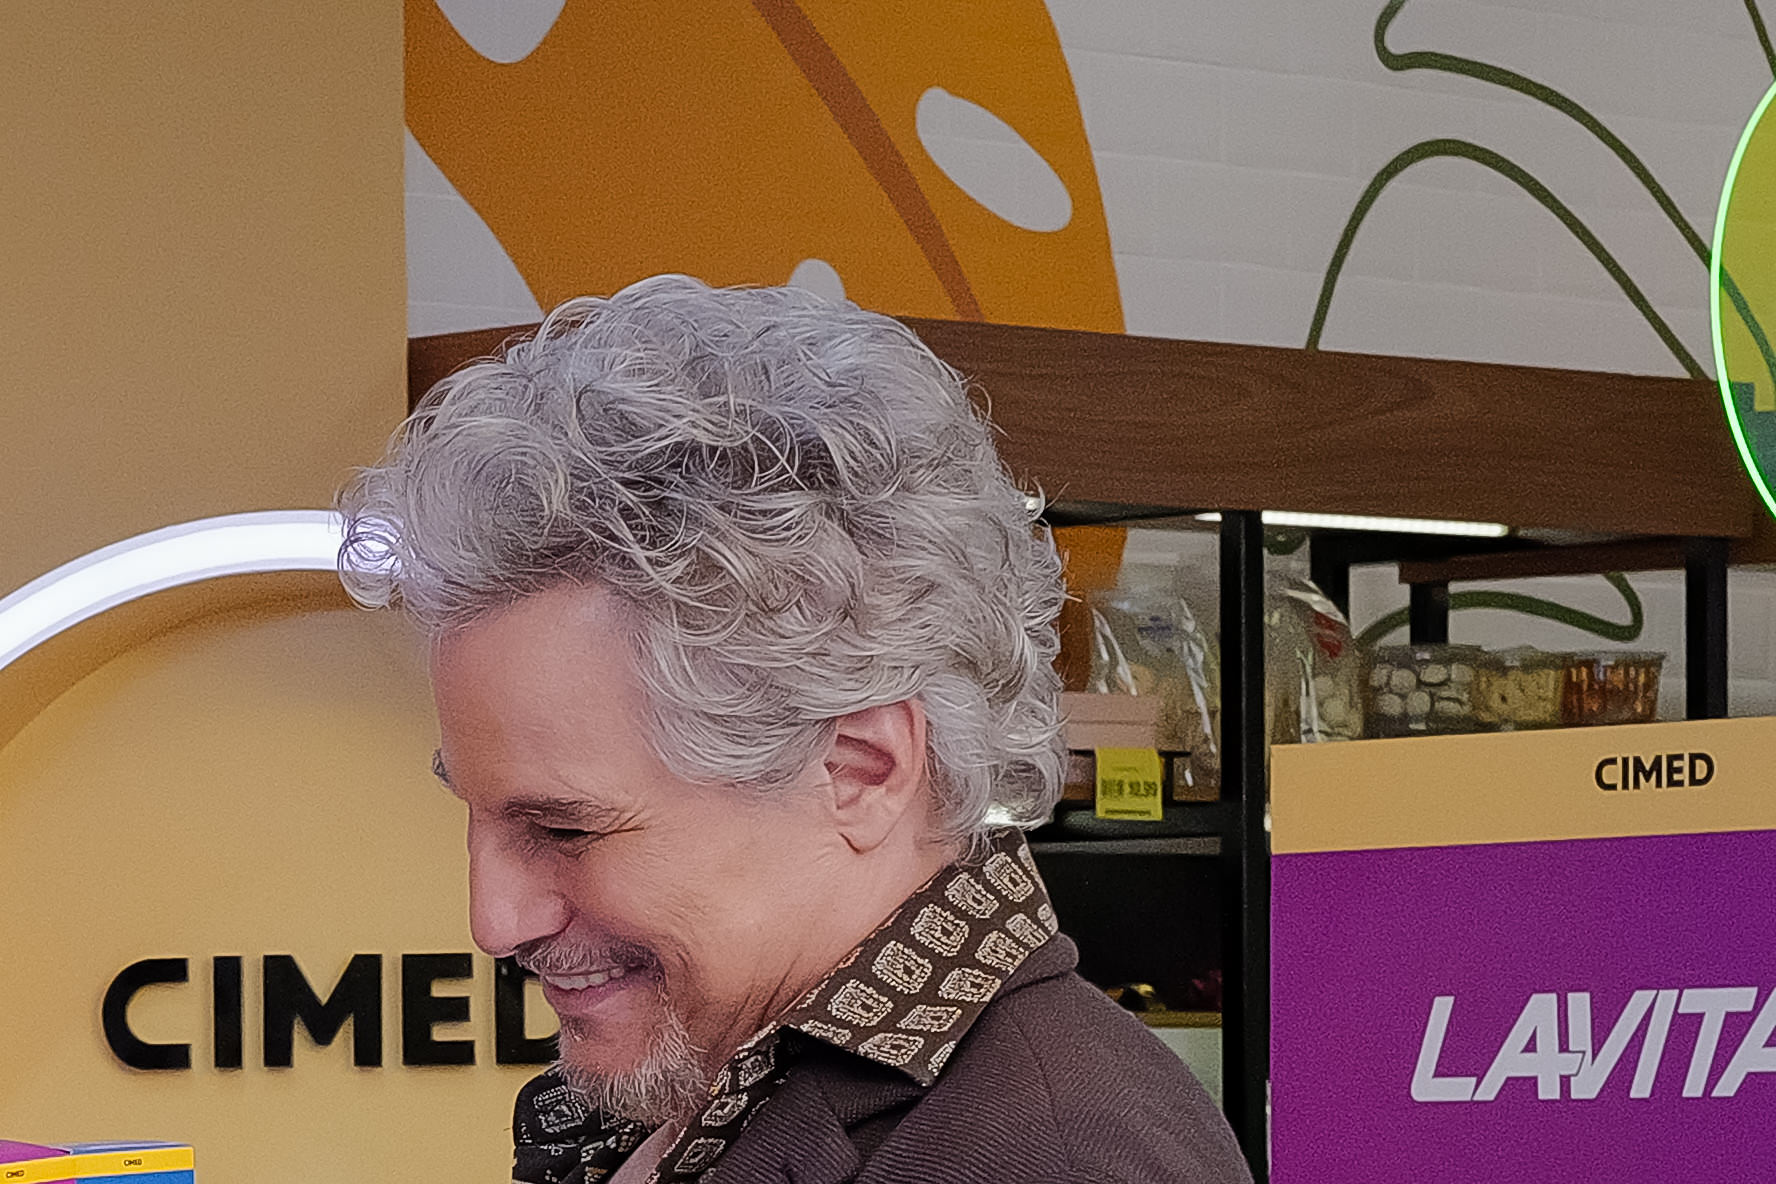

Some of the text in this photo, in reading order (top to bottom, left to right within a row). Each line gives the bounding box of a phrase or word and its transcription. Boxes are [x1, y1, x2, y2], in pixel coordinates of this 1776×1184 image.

[1595, 753, 1714, 790] CIMED
[102, 953, 561, 1070] CIMED
[1411, 986, 1776, 1102] LAVITA
